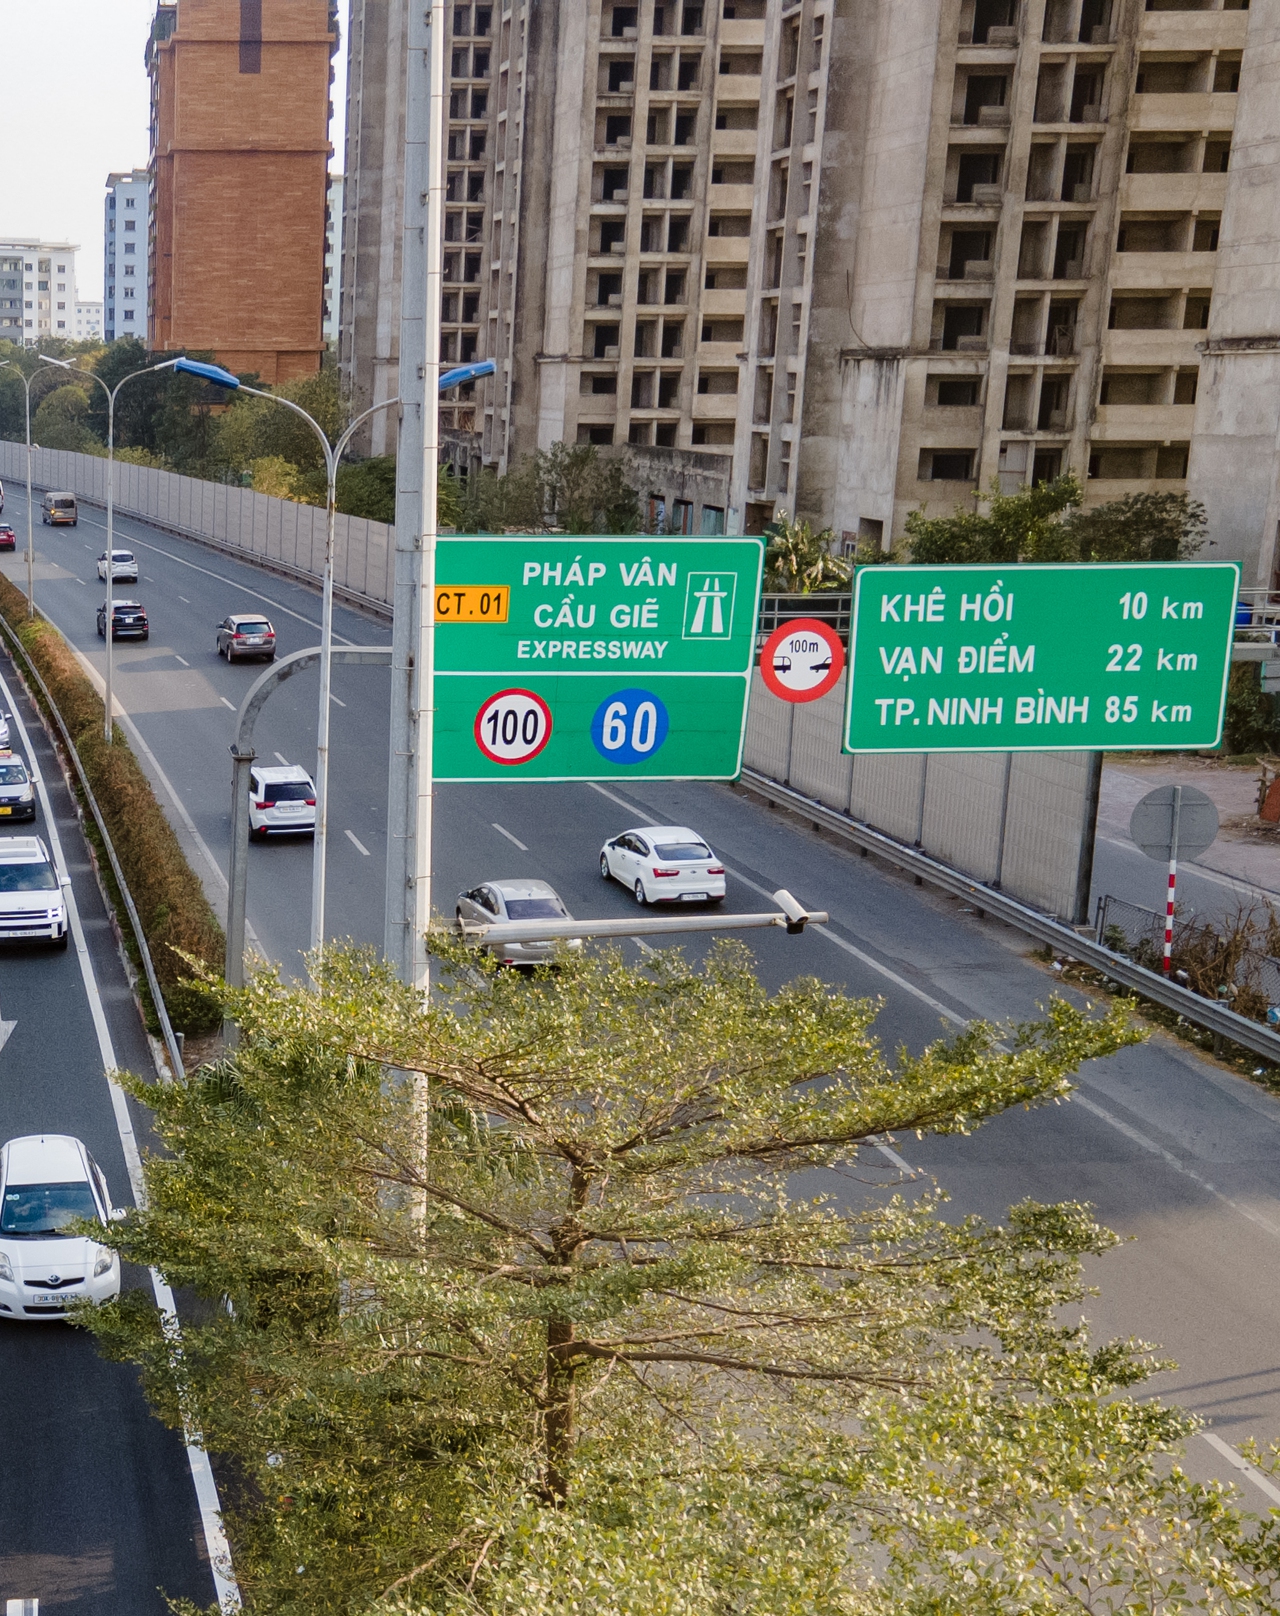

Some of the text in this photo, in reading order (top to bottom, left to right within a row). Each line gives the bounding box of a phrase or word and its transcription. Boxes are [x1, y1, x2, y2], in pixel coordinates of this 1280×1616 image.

[522, 555, 678, 586] PHÁP VÂN
[533, 593, 659, 629] CẦU GIẼ
[880, 579, 1204, 622] KHÊ HỒI 10 km
[516, 640, 669, 659] EXPRESSWAY
[789, 639, 819, 653] 100m
[879, 632, 1198, 682] VẠN ĐIỂM 22 km
[1015, 688, 1090, 724] BÌNH
[1104, 695, 1139, 723] 85
[1150, 699, 1193, 723] km
[486, 709, 539, 746] 100
[602, 701, 658, 752] 60
